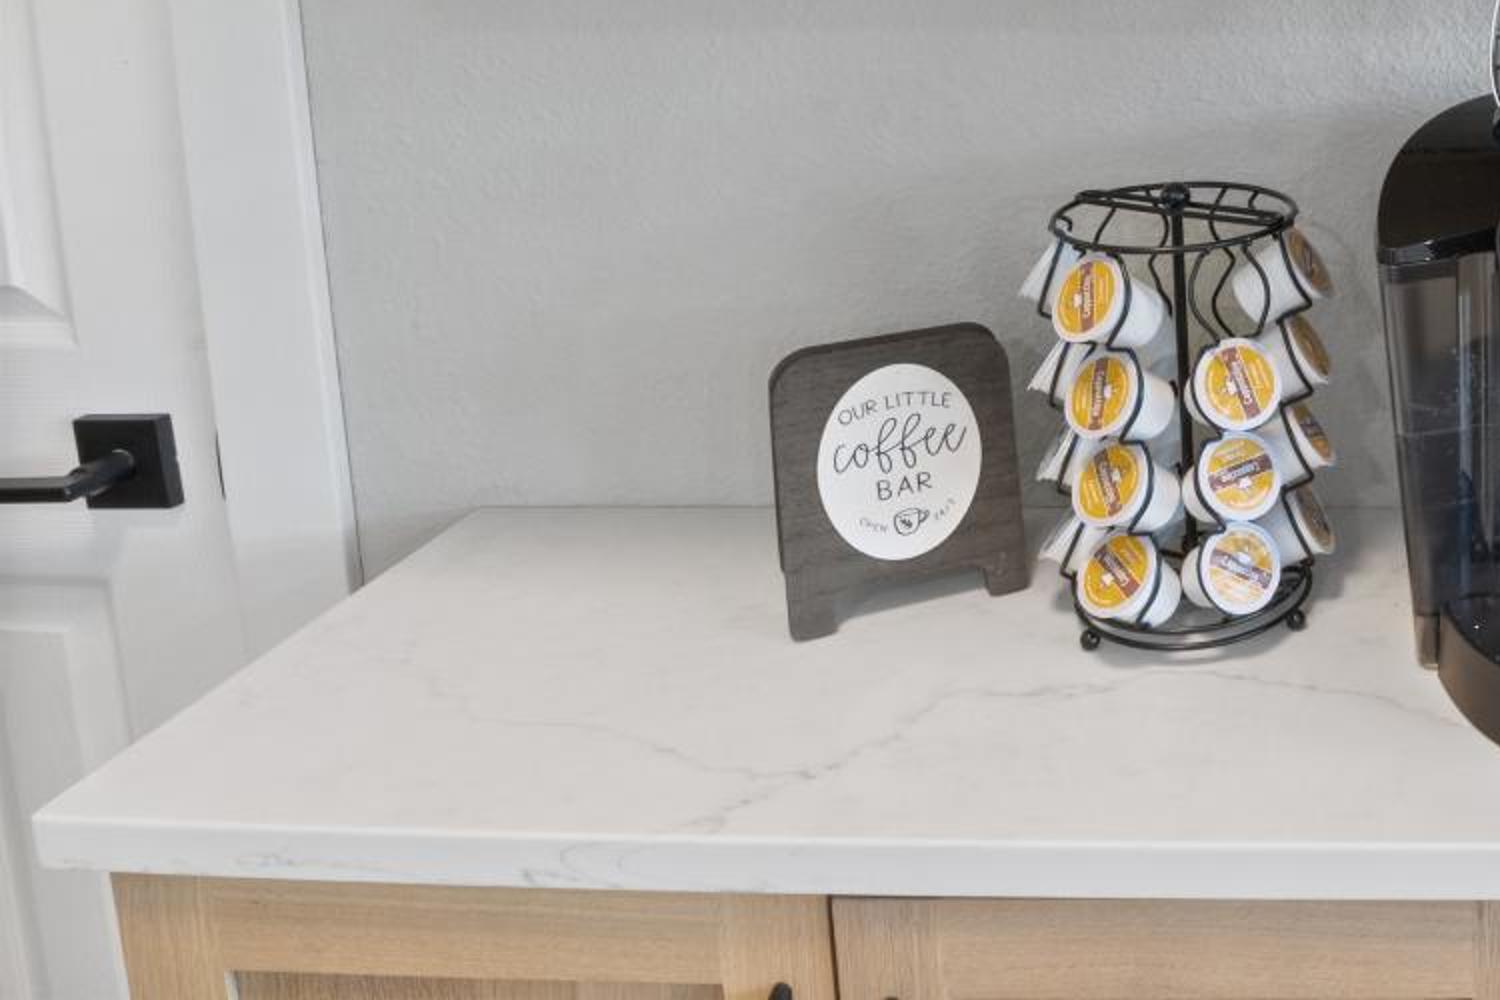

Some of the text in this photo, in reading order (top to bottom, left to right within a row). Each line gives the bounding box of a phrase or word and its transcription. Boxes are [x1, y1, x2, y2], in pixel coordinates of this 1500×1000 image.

[837, 391, 952, 426] OUR LITTLE
[833, 413, 967, 474] coffee
[876, 472, 933, 501] BAR
